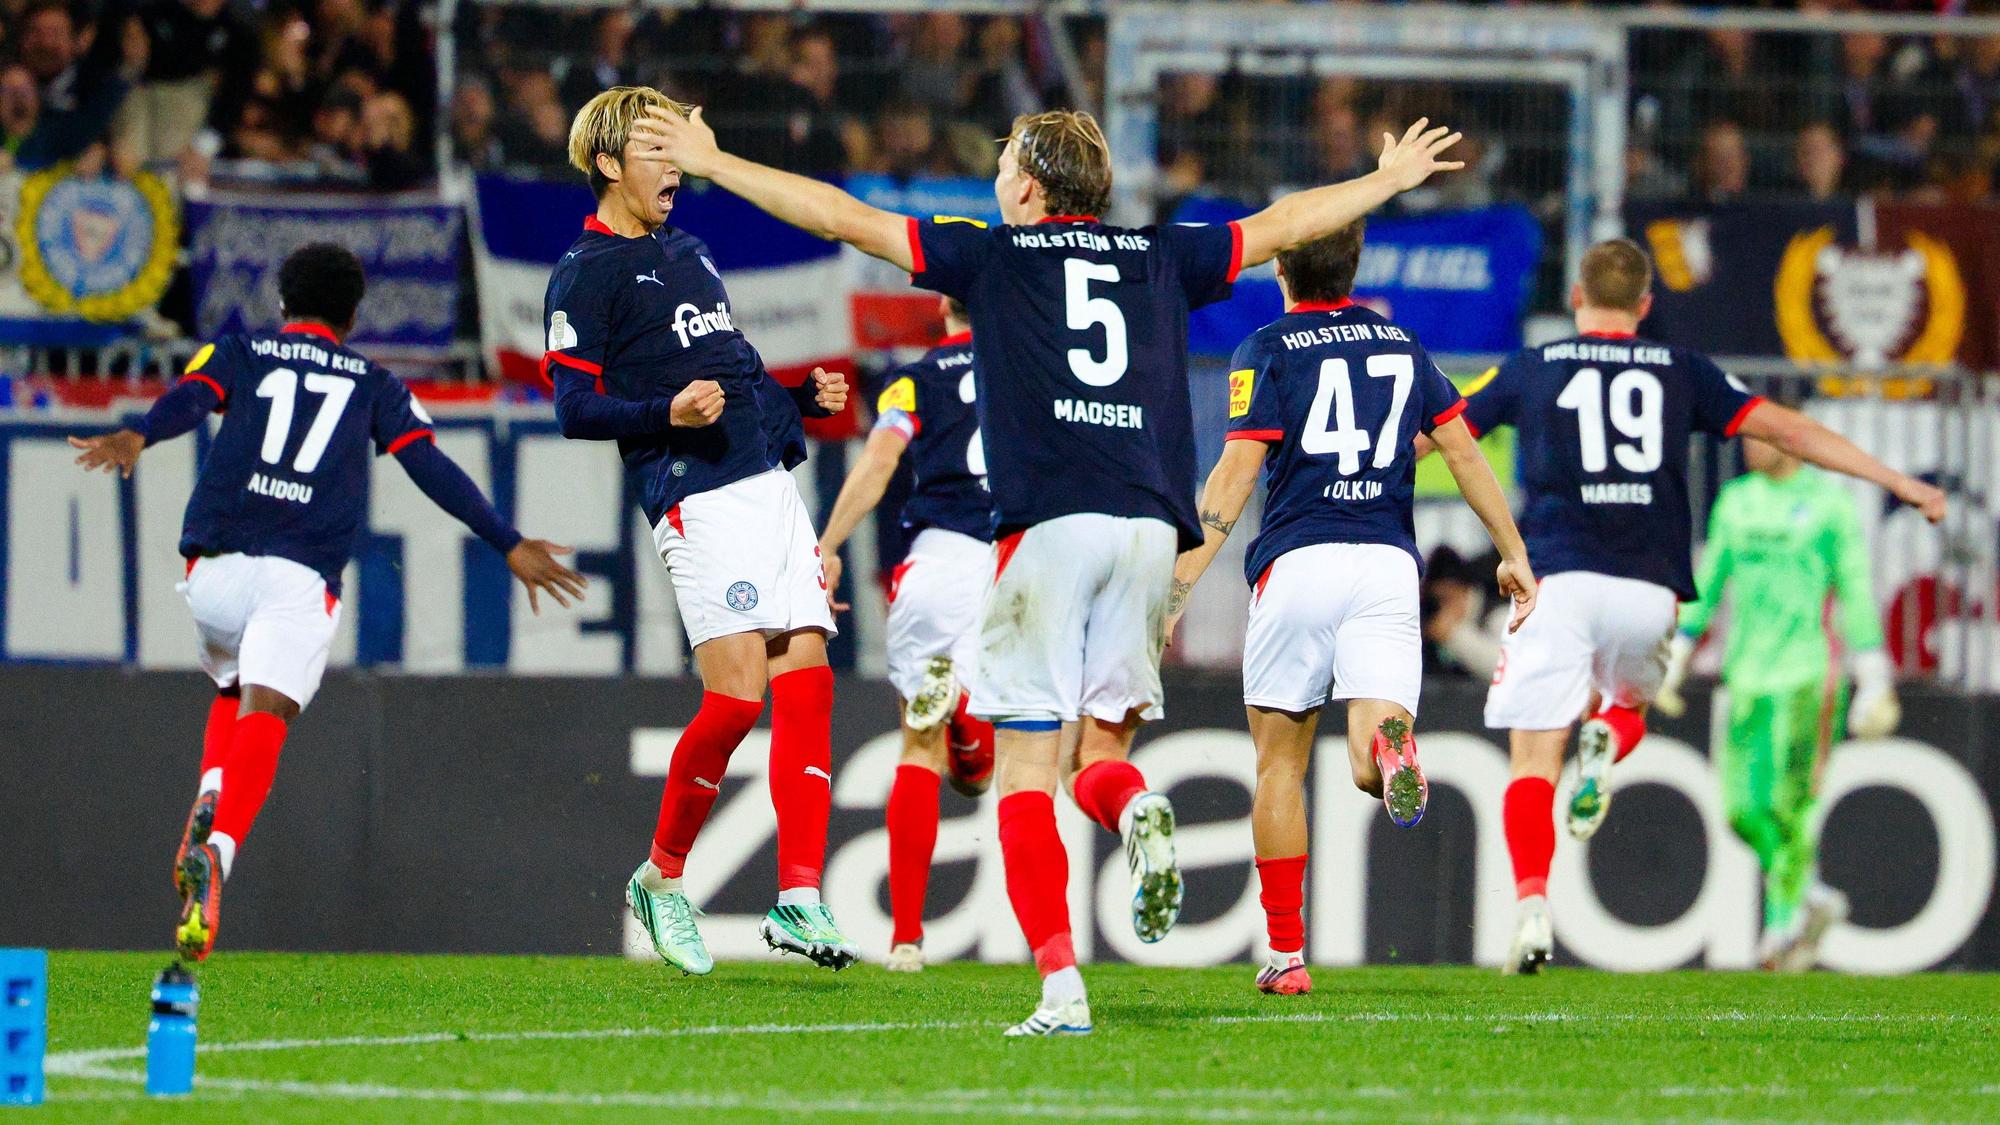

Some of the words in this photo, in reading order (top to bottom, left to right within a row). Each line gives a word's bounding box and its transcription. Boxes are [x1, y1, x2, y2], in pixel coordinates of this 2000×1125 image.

[671, 302, 735, 349] famil
[1063, 257, 1129, 387] 5
[1281, 324, 1373, 350] HOLSTEIN
[1372, 324, 1410, 343] KIEL
[331, 353, 368, 375] KIEL
[1543, 342, 1630, 364] HOLSTEIN
[1632, 345, 1674, 365] KIEL
[255, 367, 356, 474] 17
[1053, 398, 1143, 430] MADSEN
[1300, 354, 1415, 476] 47
[1555, 367, 1664, 474] 19
[247, 472, 313, 505] ALIDOU
[1580, 482, 1653, 505] HARRES
